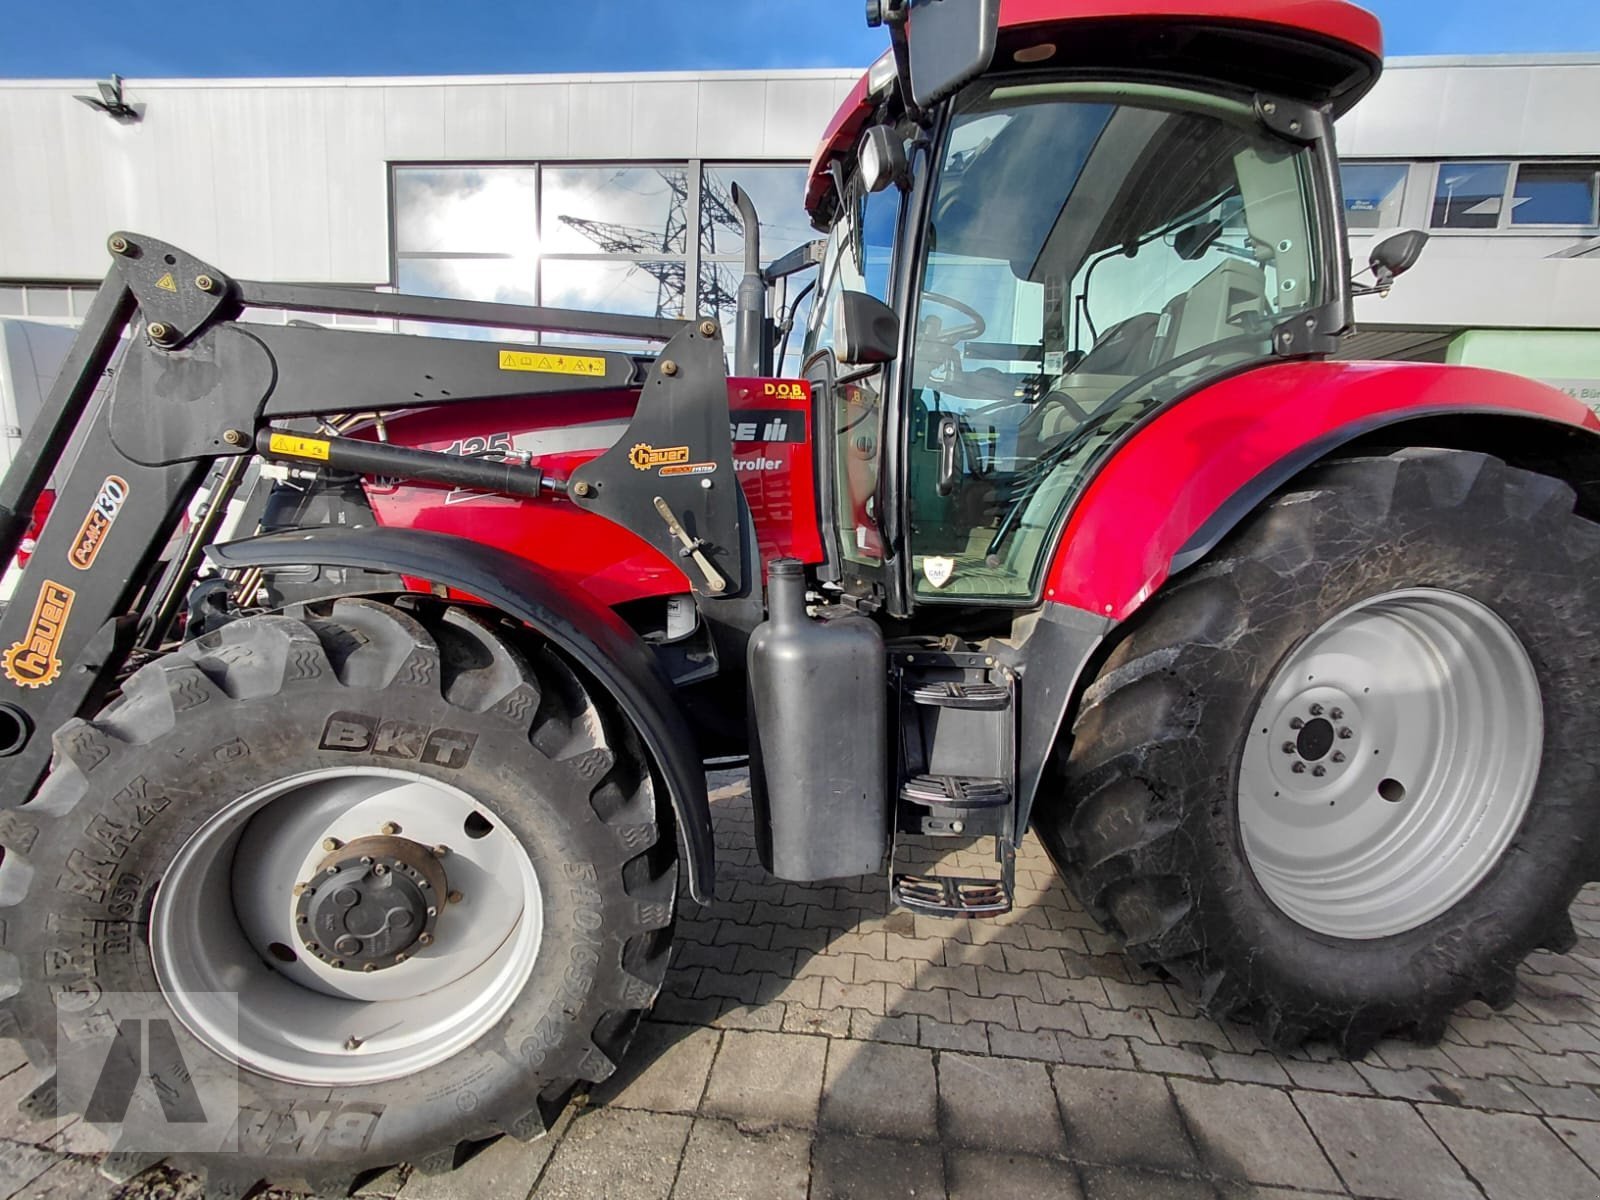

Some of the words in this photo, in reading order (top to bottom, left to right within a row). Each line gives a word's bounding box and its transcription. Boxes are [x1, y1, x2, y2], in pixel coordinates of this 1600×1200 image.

[764, 383, 804, 396] D.O.B.
[95, 480, 124, 522] 130
[320, 715, 475, 768] BKT
